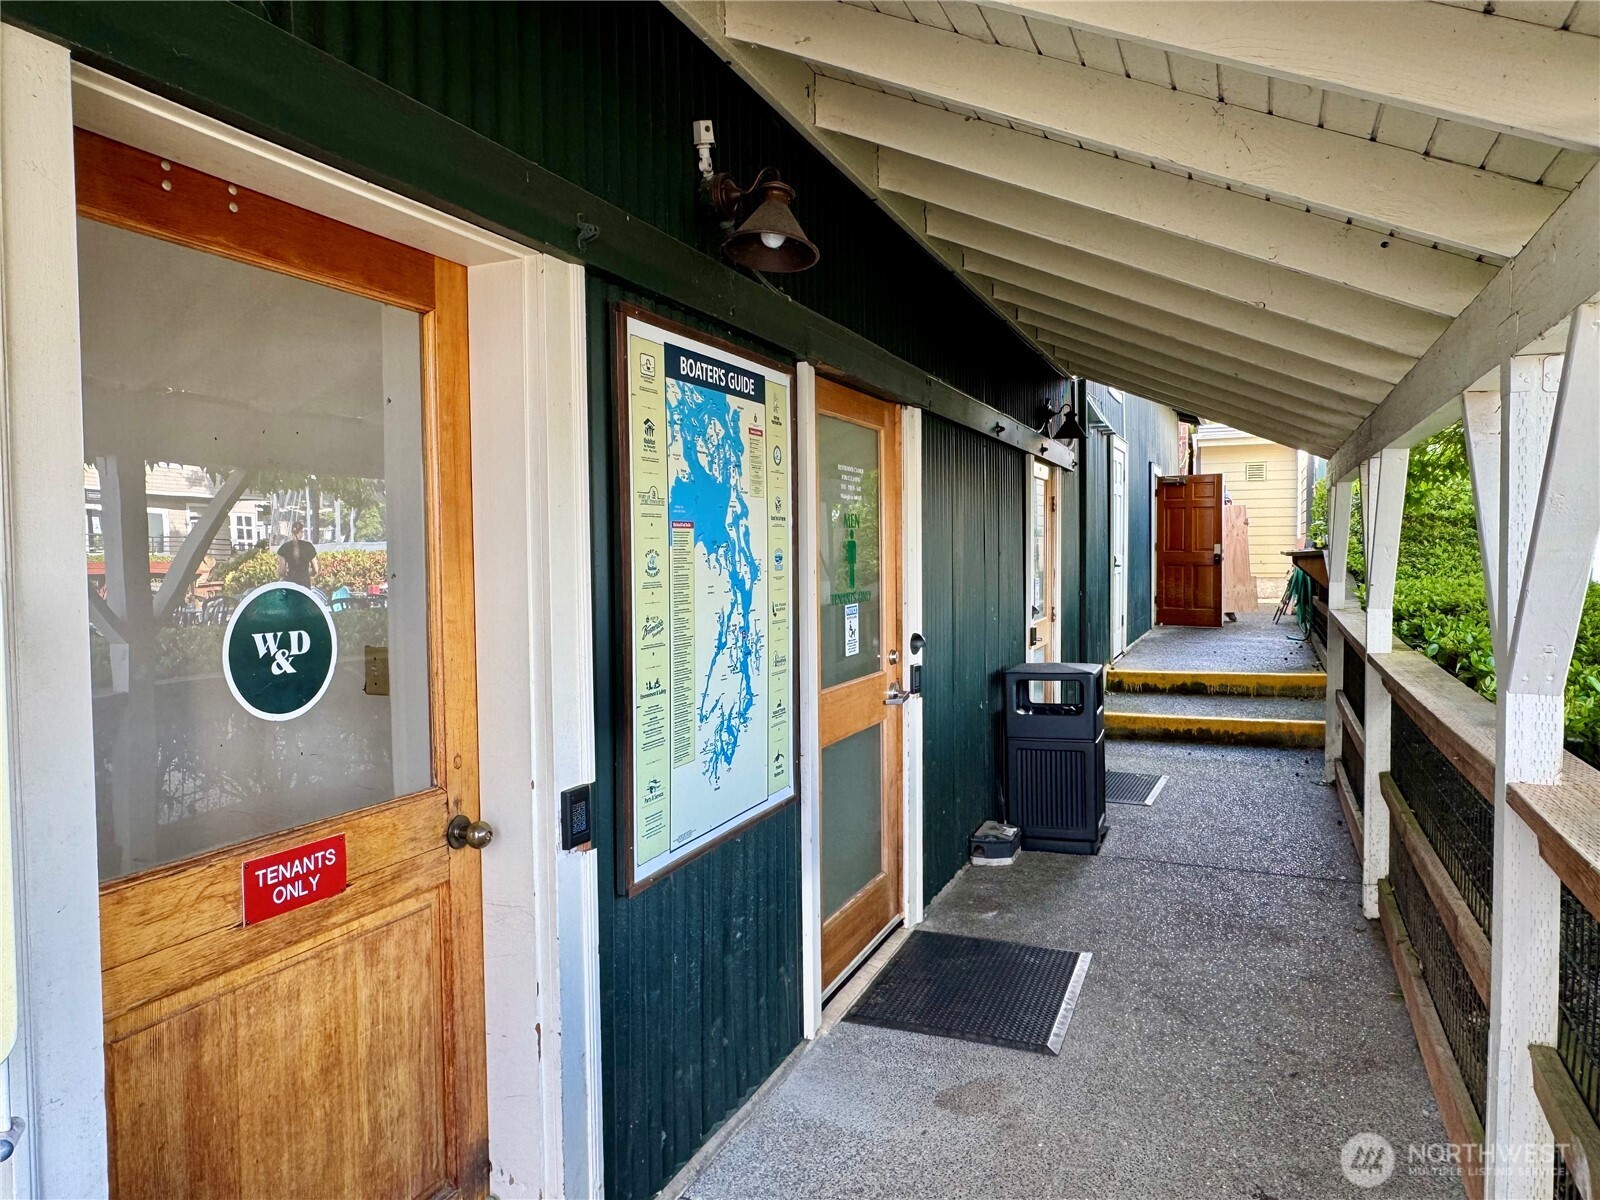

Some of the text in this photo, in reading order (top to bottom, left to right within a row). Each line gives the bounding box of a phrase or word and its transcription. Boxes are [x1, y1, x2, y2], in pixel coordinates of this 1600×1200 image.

[680, 355, 755, 396] BOATER'S GUIDE
[843, 513, 860, 529] MEN
[255, 849, 336, 888] TENANTS
[272, 874, 321, 904] ONLY
